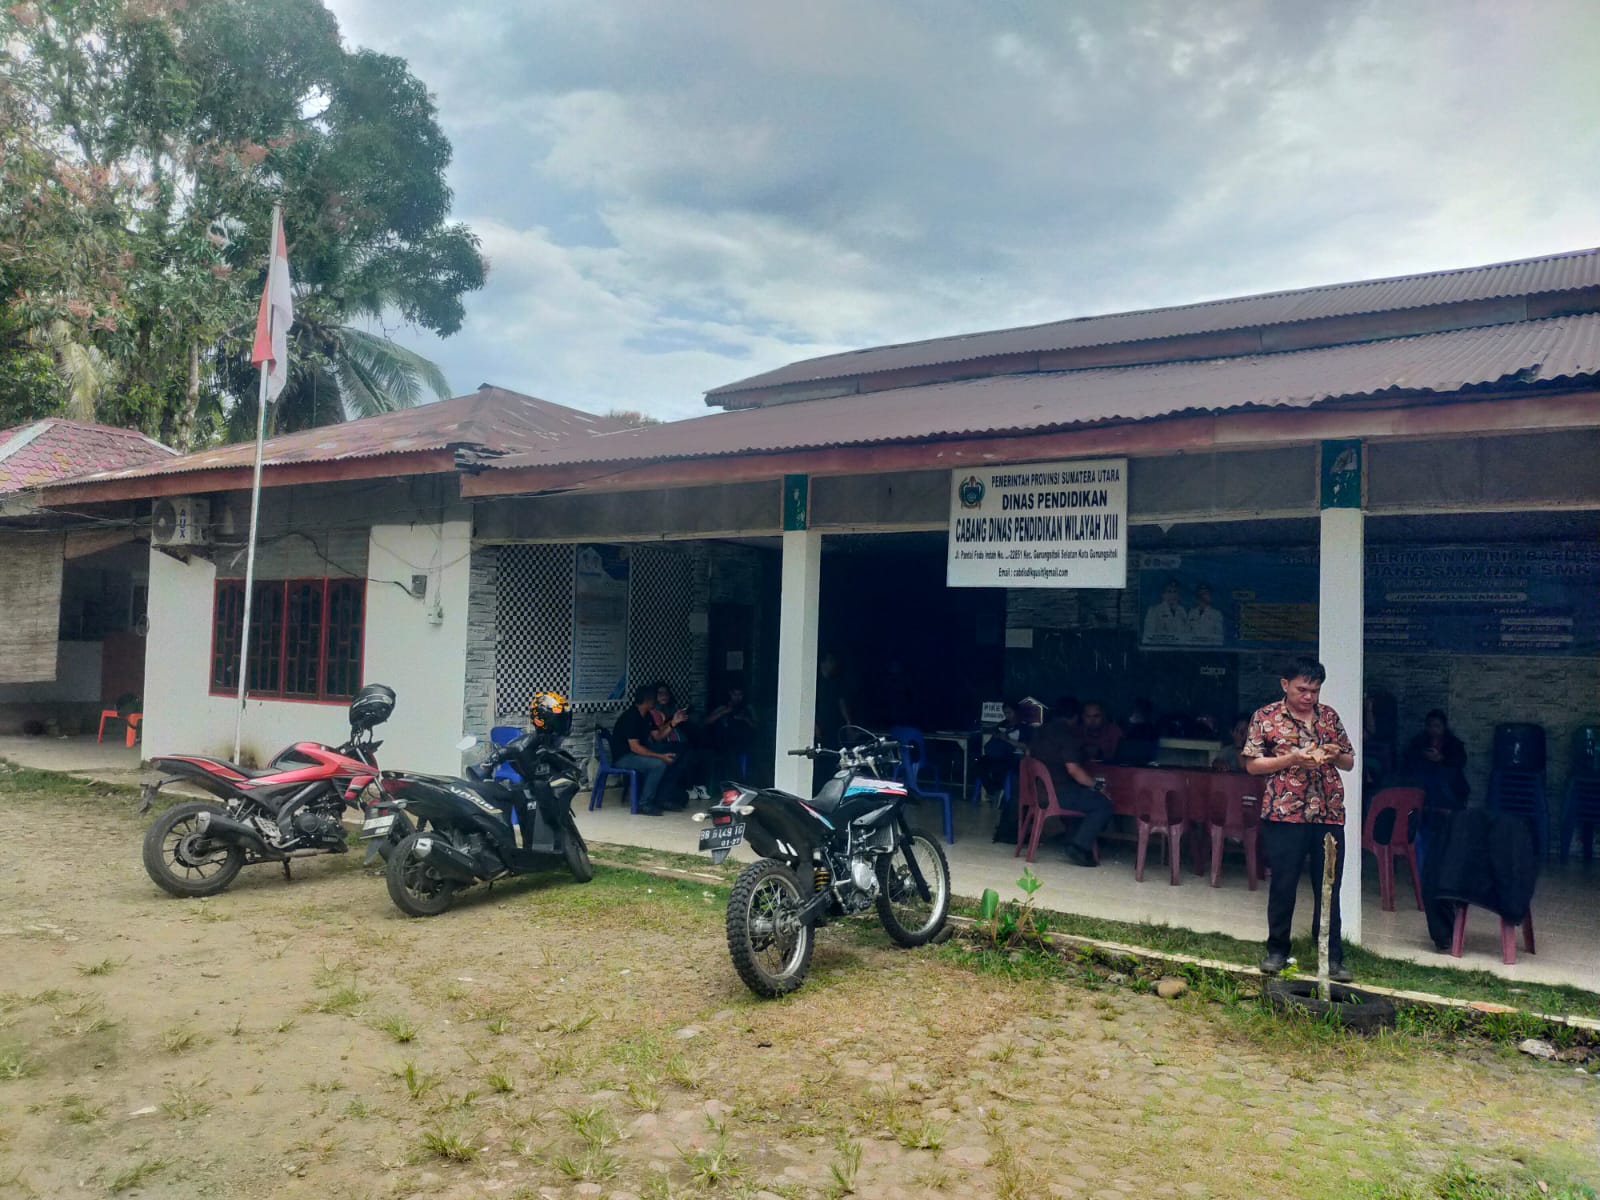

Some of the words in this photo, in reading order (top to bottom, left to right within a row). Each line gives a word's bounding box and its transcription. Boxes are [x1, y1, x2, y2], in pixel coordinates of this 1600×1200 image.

[991, 474, 1030, 488] PEMERINTAH
[1031, 472, 1060, 486] PROVINSI
[1061, 470, 1096, 485] SUMATERA
[1097, 468, 1120, 483] UTARA
[1002, 492, 1034, 510] DINAS
[1037, 489, 1108, 509] PENDIDIKAN
[179, 509, 187, 538] AUX
[955, 517, 987, 542] CABANG
[988, 516, 1012, 542] DINAS
[1014, 515, 1062, 542] PENDIDIKAN
[1064, 514, 1101, 541] WILAYAH
[1102, 513, 1118, 540] XIII
[450, 786, 494, 810] VARIO
